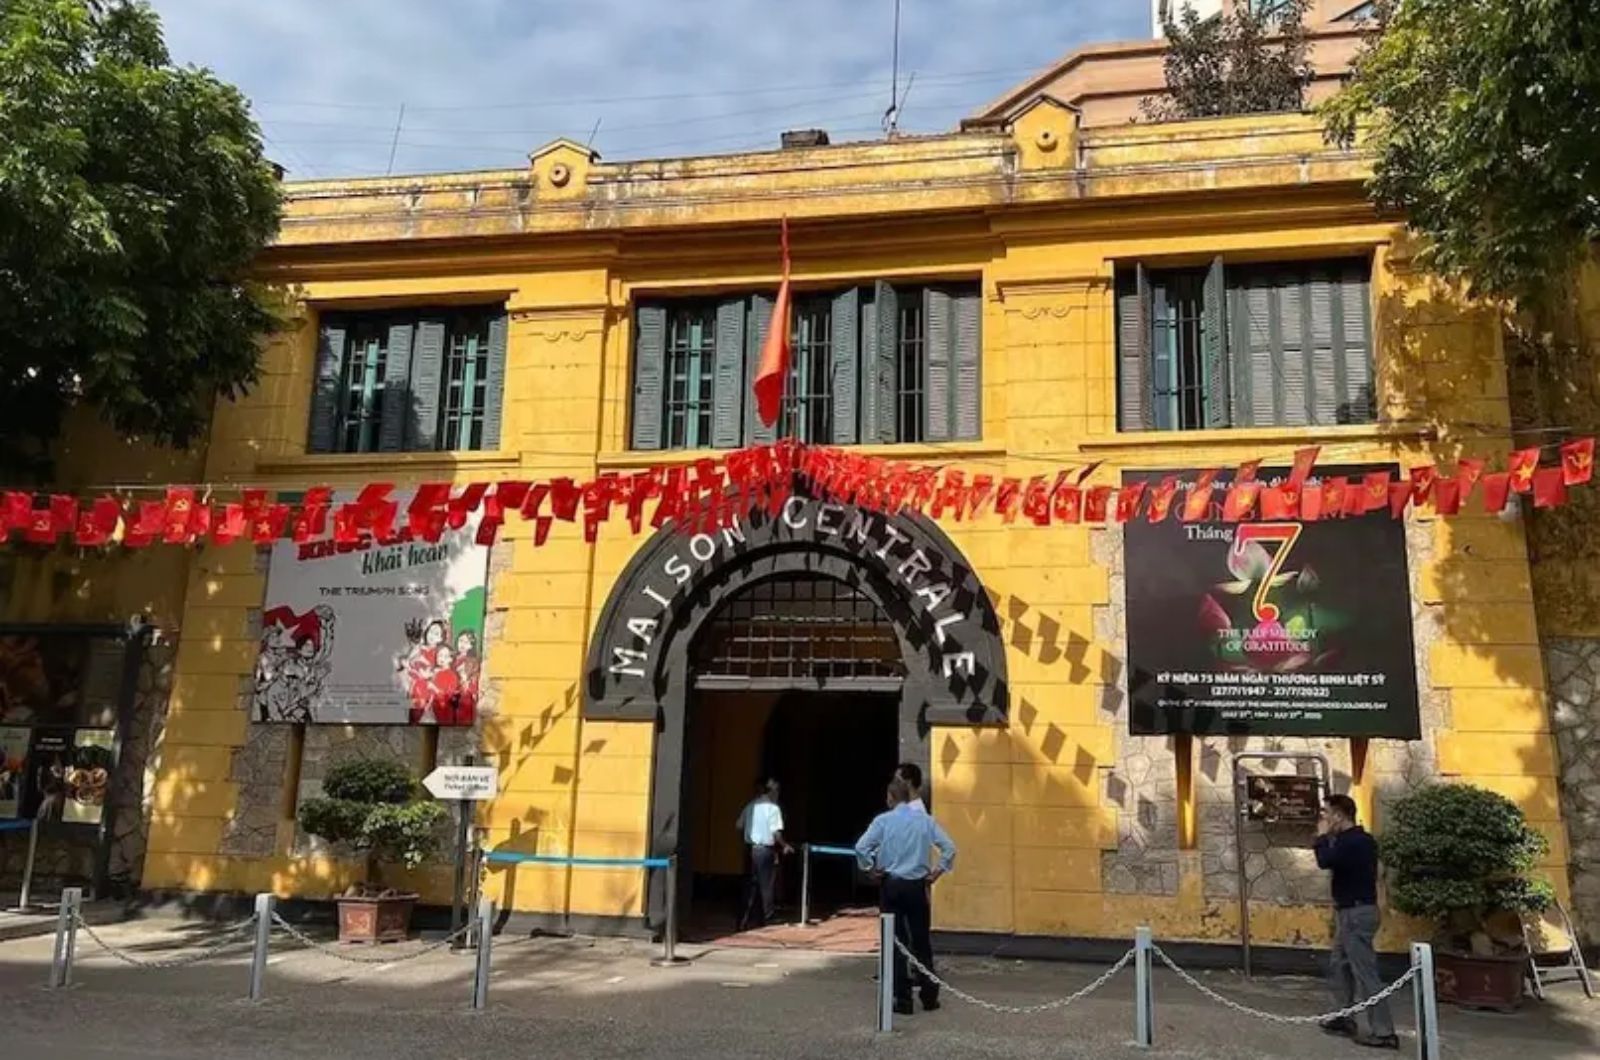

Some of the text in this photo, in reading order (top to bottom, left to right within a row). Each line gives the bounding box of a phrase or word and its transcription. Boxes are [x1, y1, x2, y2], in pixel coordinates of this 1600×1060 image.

[1183, 522, 1302, 622] Tháng 7
[319, 586, 430, 596] THE TRIUMPH SONG
[609, 496, 975, 679] MAISON CENTRALE
[1217, 628, 1241, 638] THE
[1226, 641, 1310, 652] OF GRATITUDE
